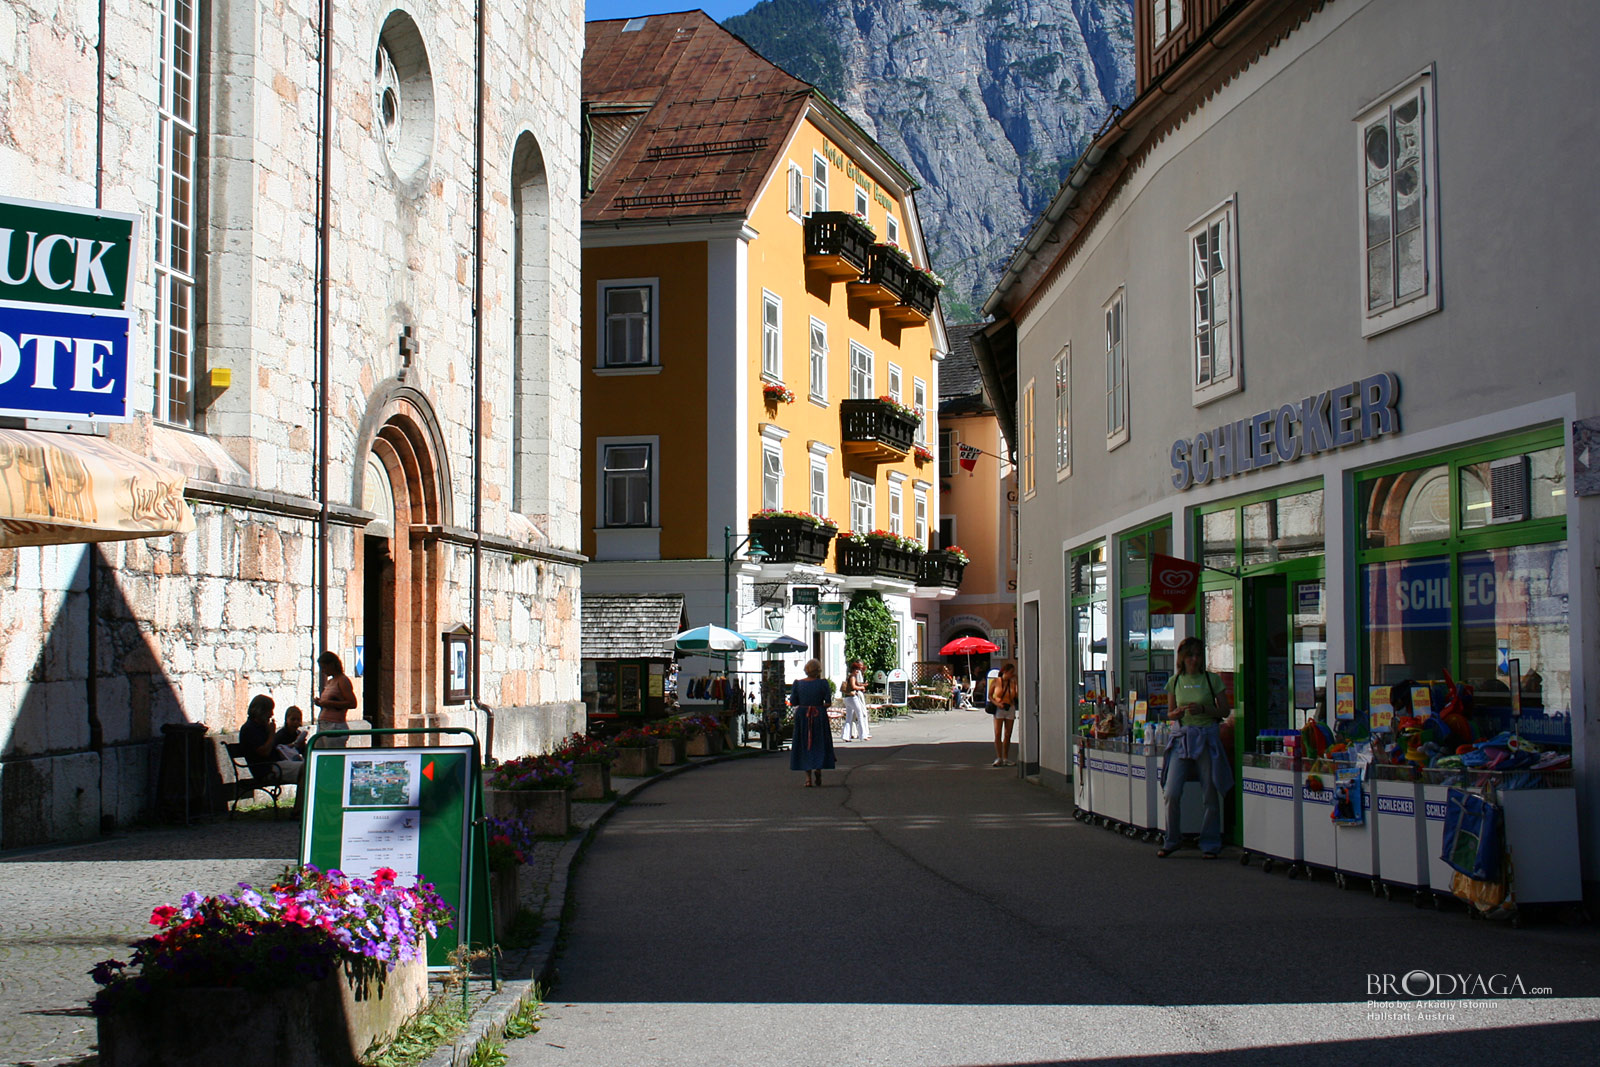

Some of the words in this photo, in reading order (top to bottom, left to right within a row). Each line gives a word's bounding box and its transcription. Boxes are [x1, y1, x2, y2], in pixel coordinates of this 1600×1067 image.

[1169, 371, 1402, 491] SCHLECKER
[1162, 588, 1186, 596] ESKIMO
[1243, 780, 1266, 793] SCHLECKER
[1266, 784, 1293, 798] SCHLECKER
[1378, 797, 1414, 813] SCHLECKER
